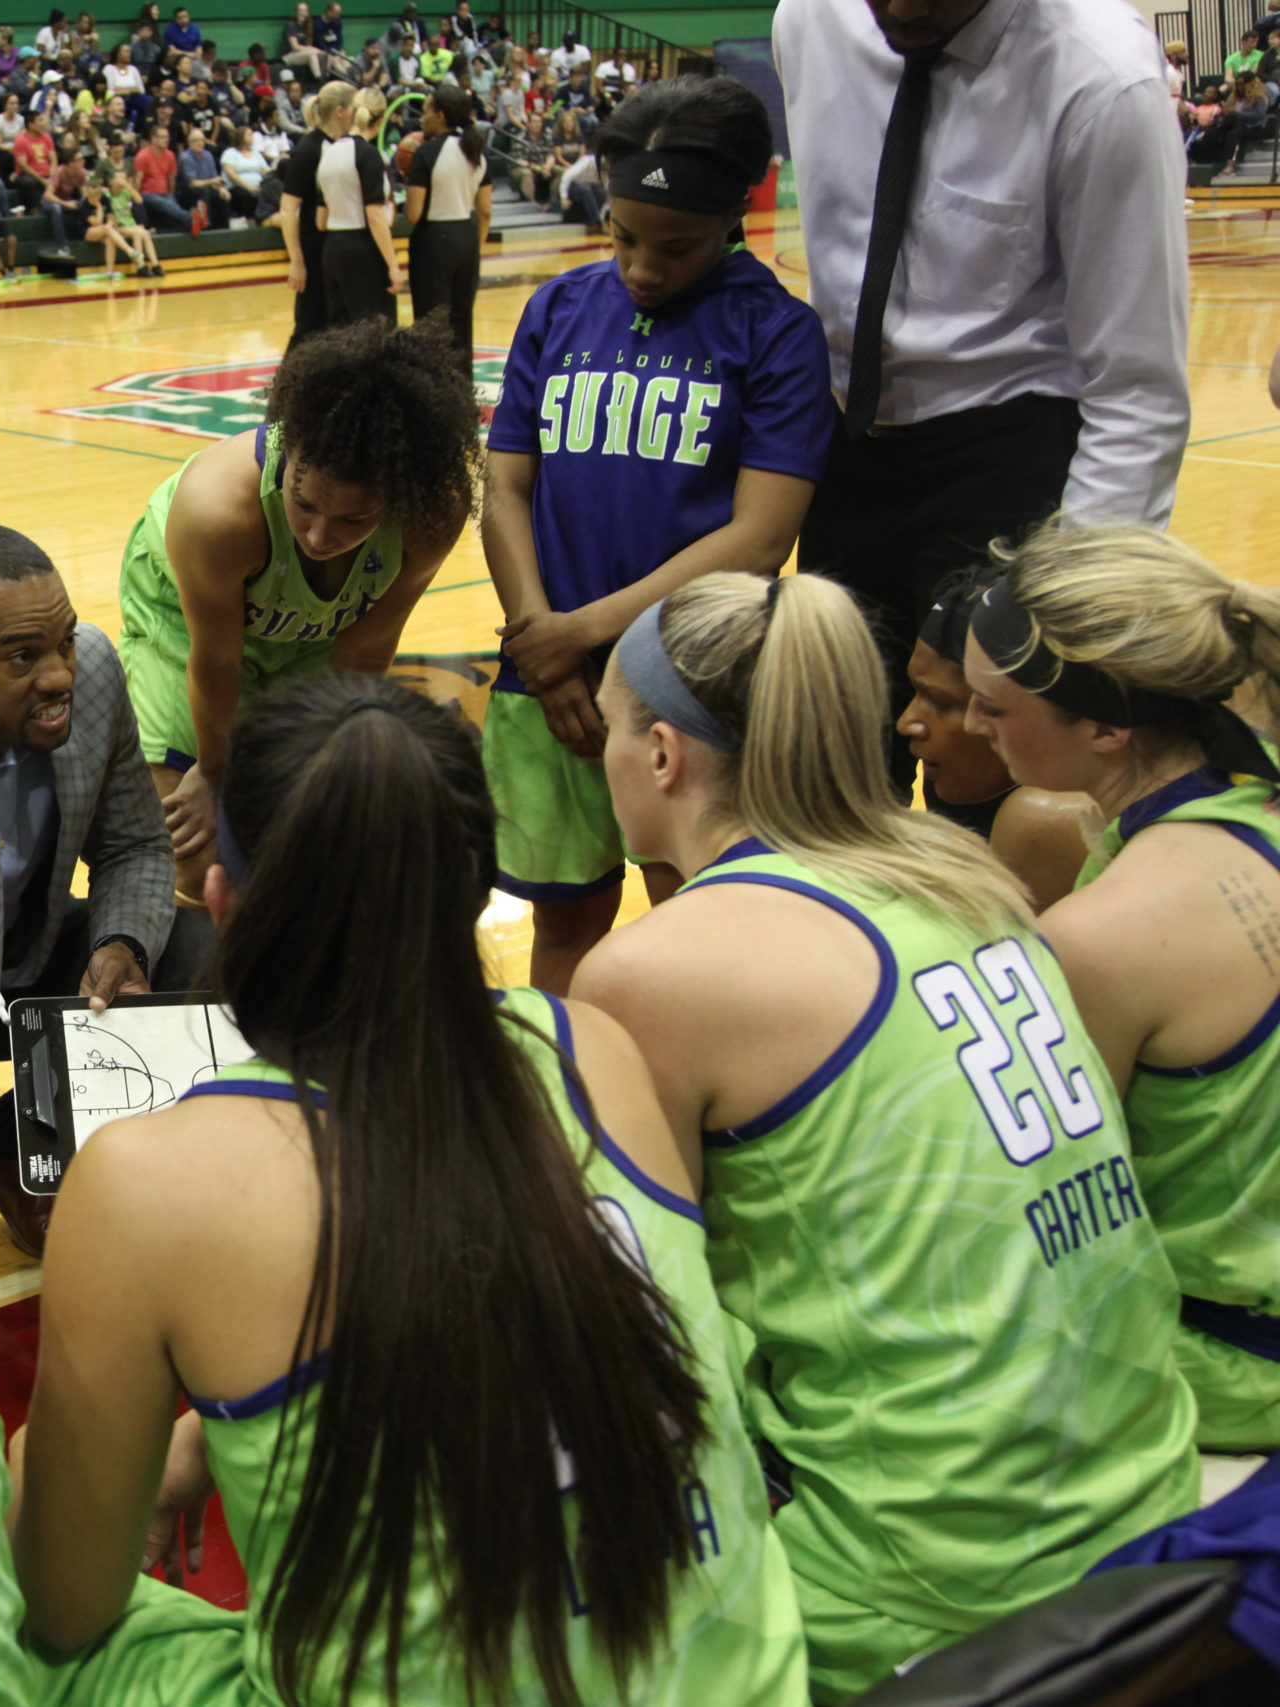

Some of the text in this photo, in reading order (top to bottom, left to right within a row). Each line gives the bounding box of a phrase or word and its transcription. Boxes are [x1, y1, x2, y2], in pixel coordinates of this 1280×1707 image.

[641, 178, 669, 190] adidas
[562, 350, 713, 375] ST. LOUIS
[539, 371, 722, 466] SURGE
[911, 936, 1104, 1168] 22
[1024, 1154, 1143, 1269] CARTER
